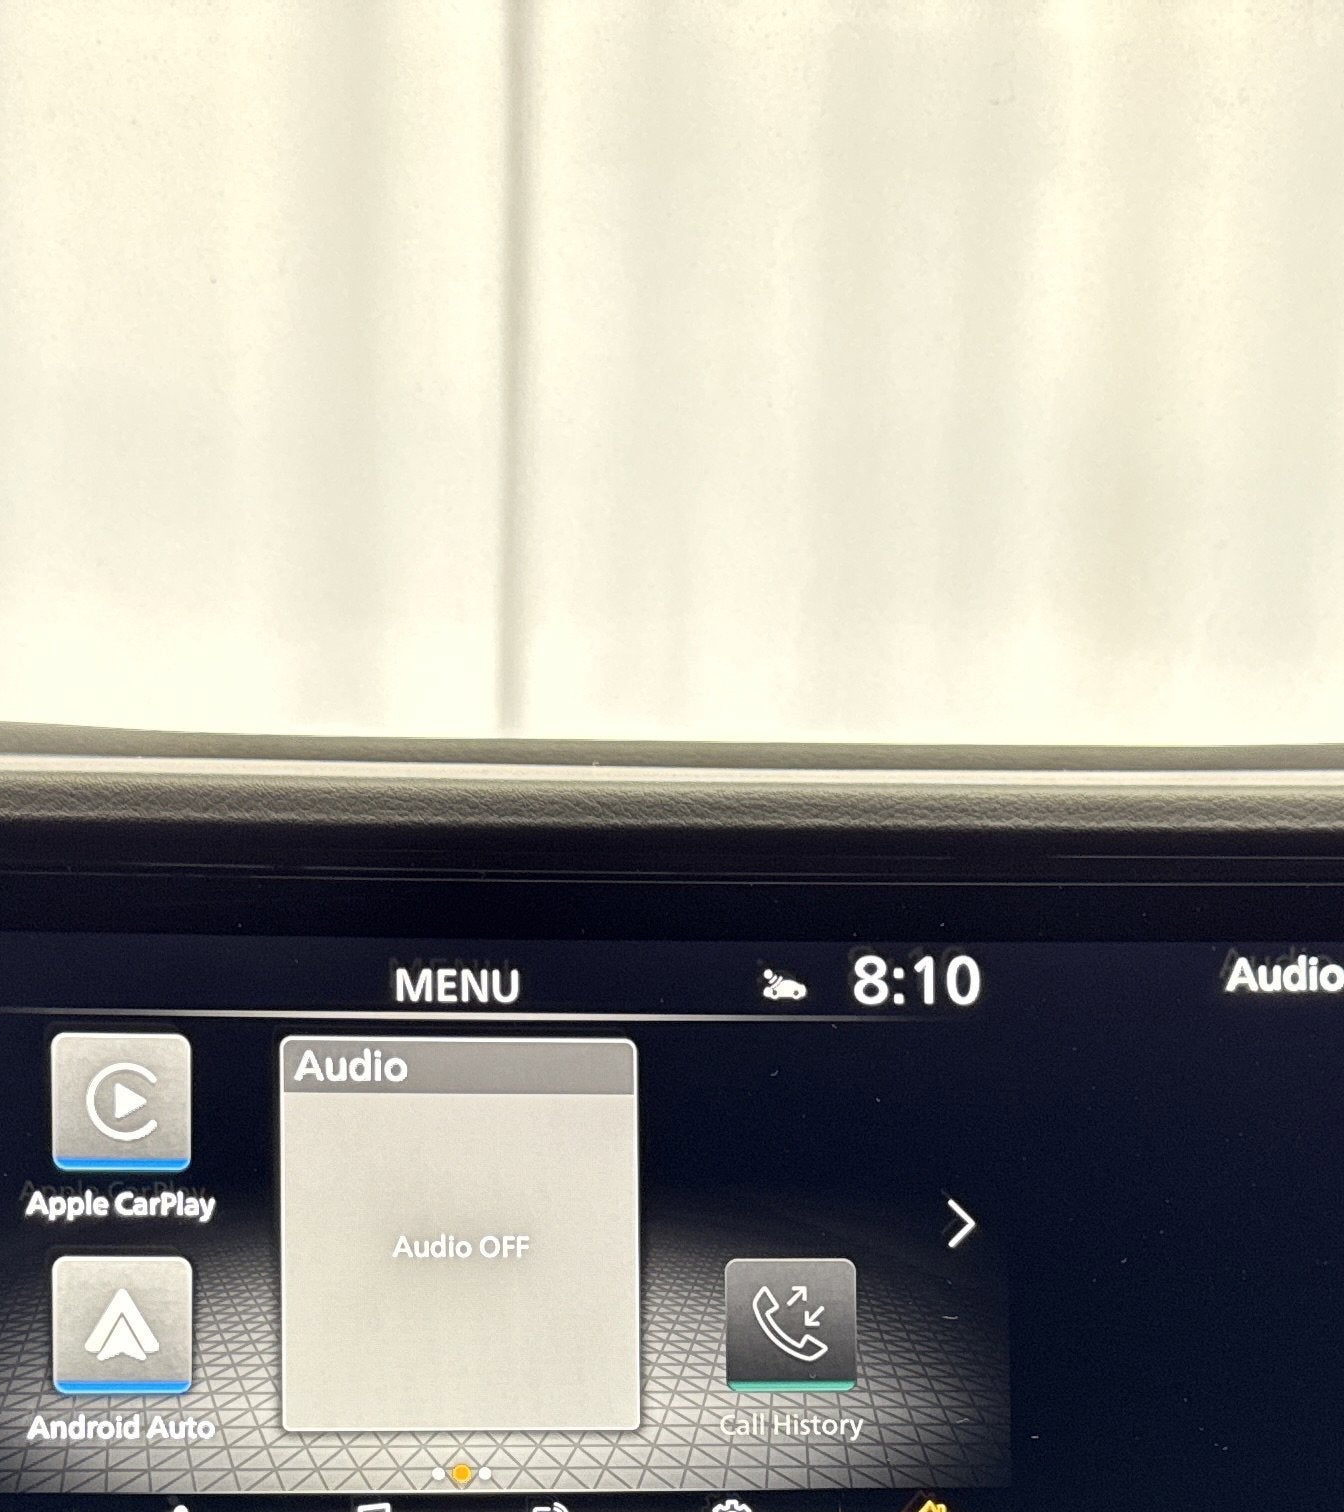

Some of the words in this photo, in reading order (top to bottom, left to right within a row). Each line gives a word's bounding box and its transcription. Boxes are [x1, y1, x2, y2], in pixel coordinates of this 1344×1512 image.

[394, 967, 520, 1003] MENU
[852, 954, 981, 1006] 8:10
[293, 1048, 408, 1083] Audio
[25, 1190, 109, 1222] Apple
[114, 1190, 216, 1222] CarPlay
[392, 1234, 473, 1260] Audio
[479, 1235, 531, 1260] OFF
[27, 1414, 141, 1441] Android
[146, 1415, 216, 1441] Auto
[719, 1412, 766, 1437] Call
[772, 1412, 865, 1443] History
